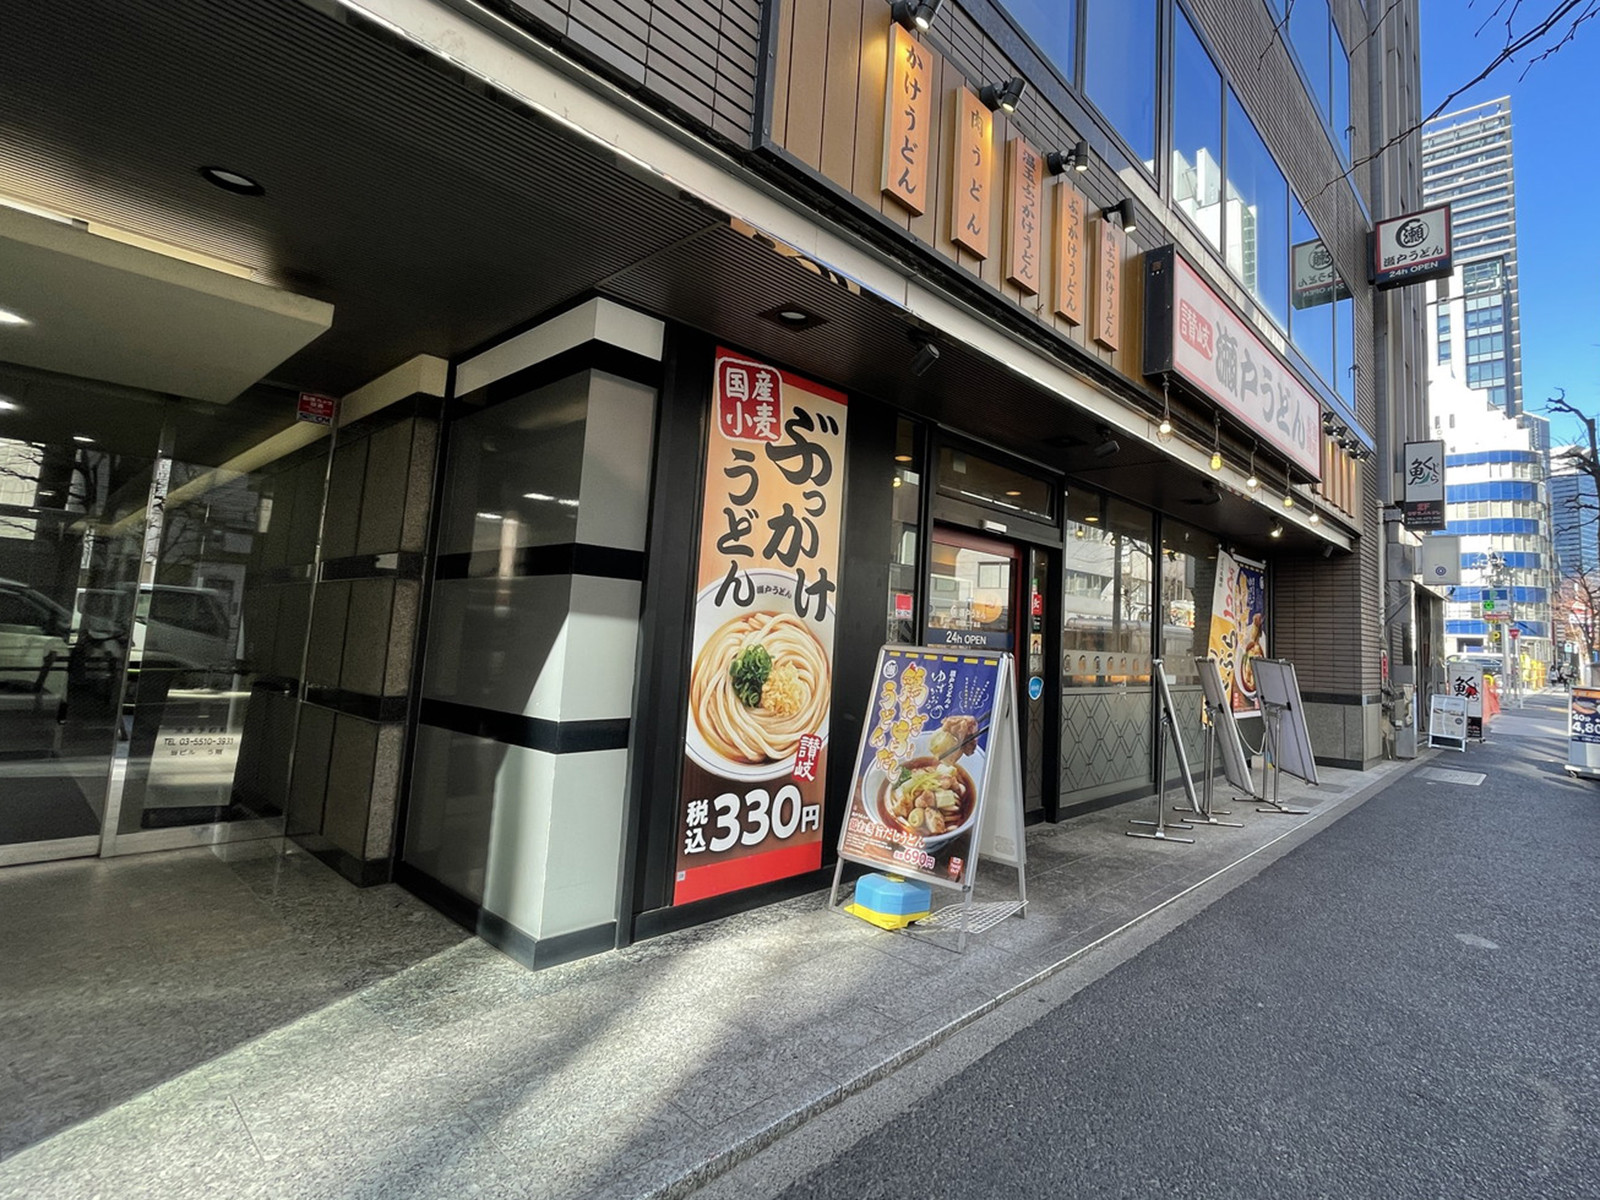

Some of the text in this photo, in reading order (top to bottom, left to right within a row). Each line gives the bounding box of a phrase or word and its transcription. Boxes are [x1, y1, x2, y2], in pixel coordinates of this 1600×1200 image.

[897, 45, 924, 195] かけうどん
[966, 109, 985, 236] 肉うどん
[1388, 261, 1439, 278] 24h OPEN
[725, 366, 775, 402] 国産
[1215, 321, 1306, 450] 瀬戸うどん
[725, 401, 778, 440] 小麦
[714, 448, 759, 607] うどん
[762, 406, 839, 622] ぶっかけ
[946, 631, 987, 646] 24h OPEN
[164, 737, 176, 746] TEL
[794, 737, 820, 782] 讃岐
[684, 784, 820, 855] 税込 330円
[904, 848, 935, 869] 690円
